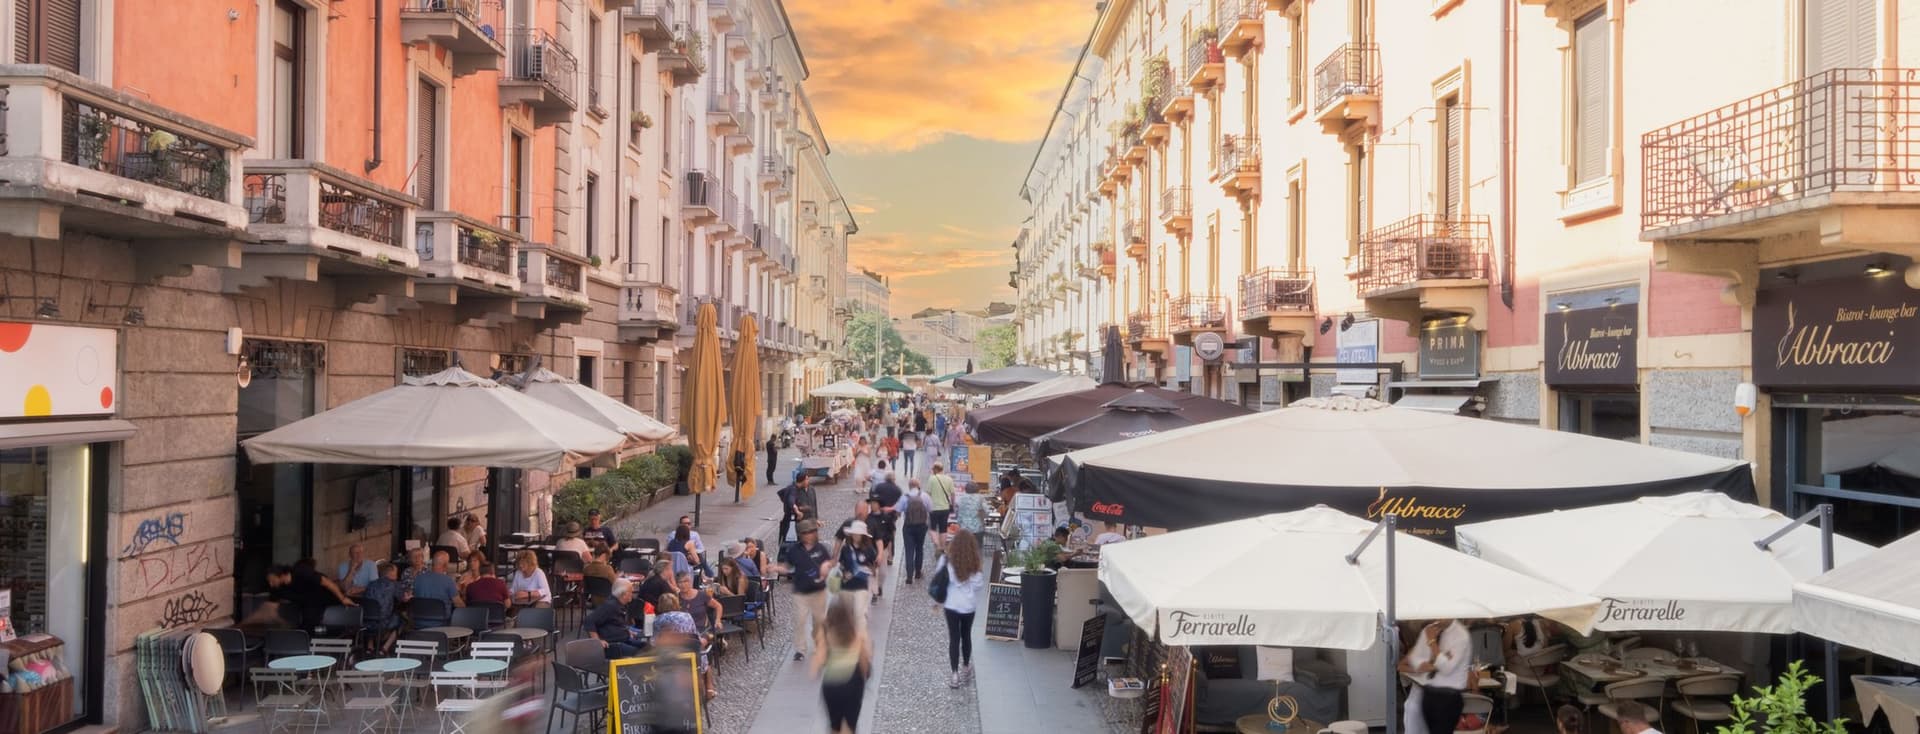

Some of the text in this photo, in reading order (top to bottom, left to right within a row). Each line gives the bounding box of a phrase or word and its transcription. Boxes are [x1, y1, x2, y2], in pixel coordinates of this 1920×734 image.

[1836, 307, 1864, 322] Bistrot
[1869, 304, 1900, 323] lounge
[1900, 301, 1918, 318] bar
[1430, 335, 1465, 350] PRIMA
[1562, 338, 1621, 370] Abbracci
[1785, 324, 1895, 366] Abbracci
[1374, 495, 1466, 519] Abbracci
[1599, 597, 1685, 623] Ferrarelle
[1169, 610, 1256, 638] Ferrarelle
